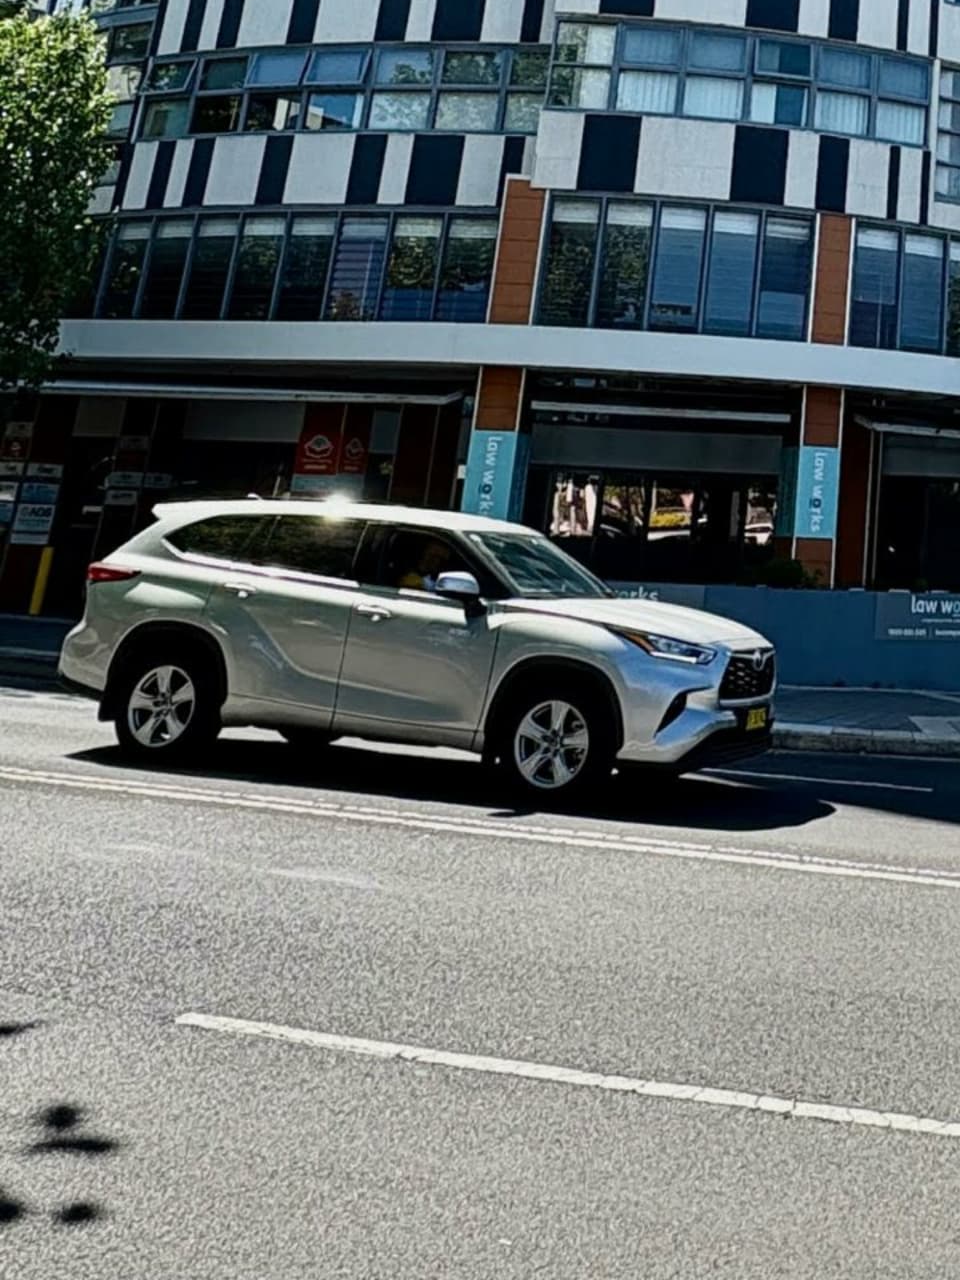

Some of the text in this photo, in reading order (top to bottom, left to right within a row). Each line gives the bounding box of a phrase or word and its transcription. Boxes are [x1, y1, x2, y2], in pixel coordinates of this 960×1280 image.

[479, 435, 503, 514] law work
[809, 451, 828, 533] law works
[911, 595, 938, 613] law
